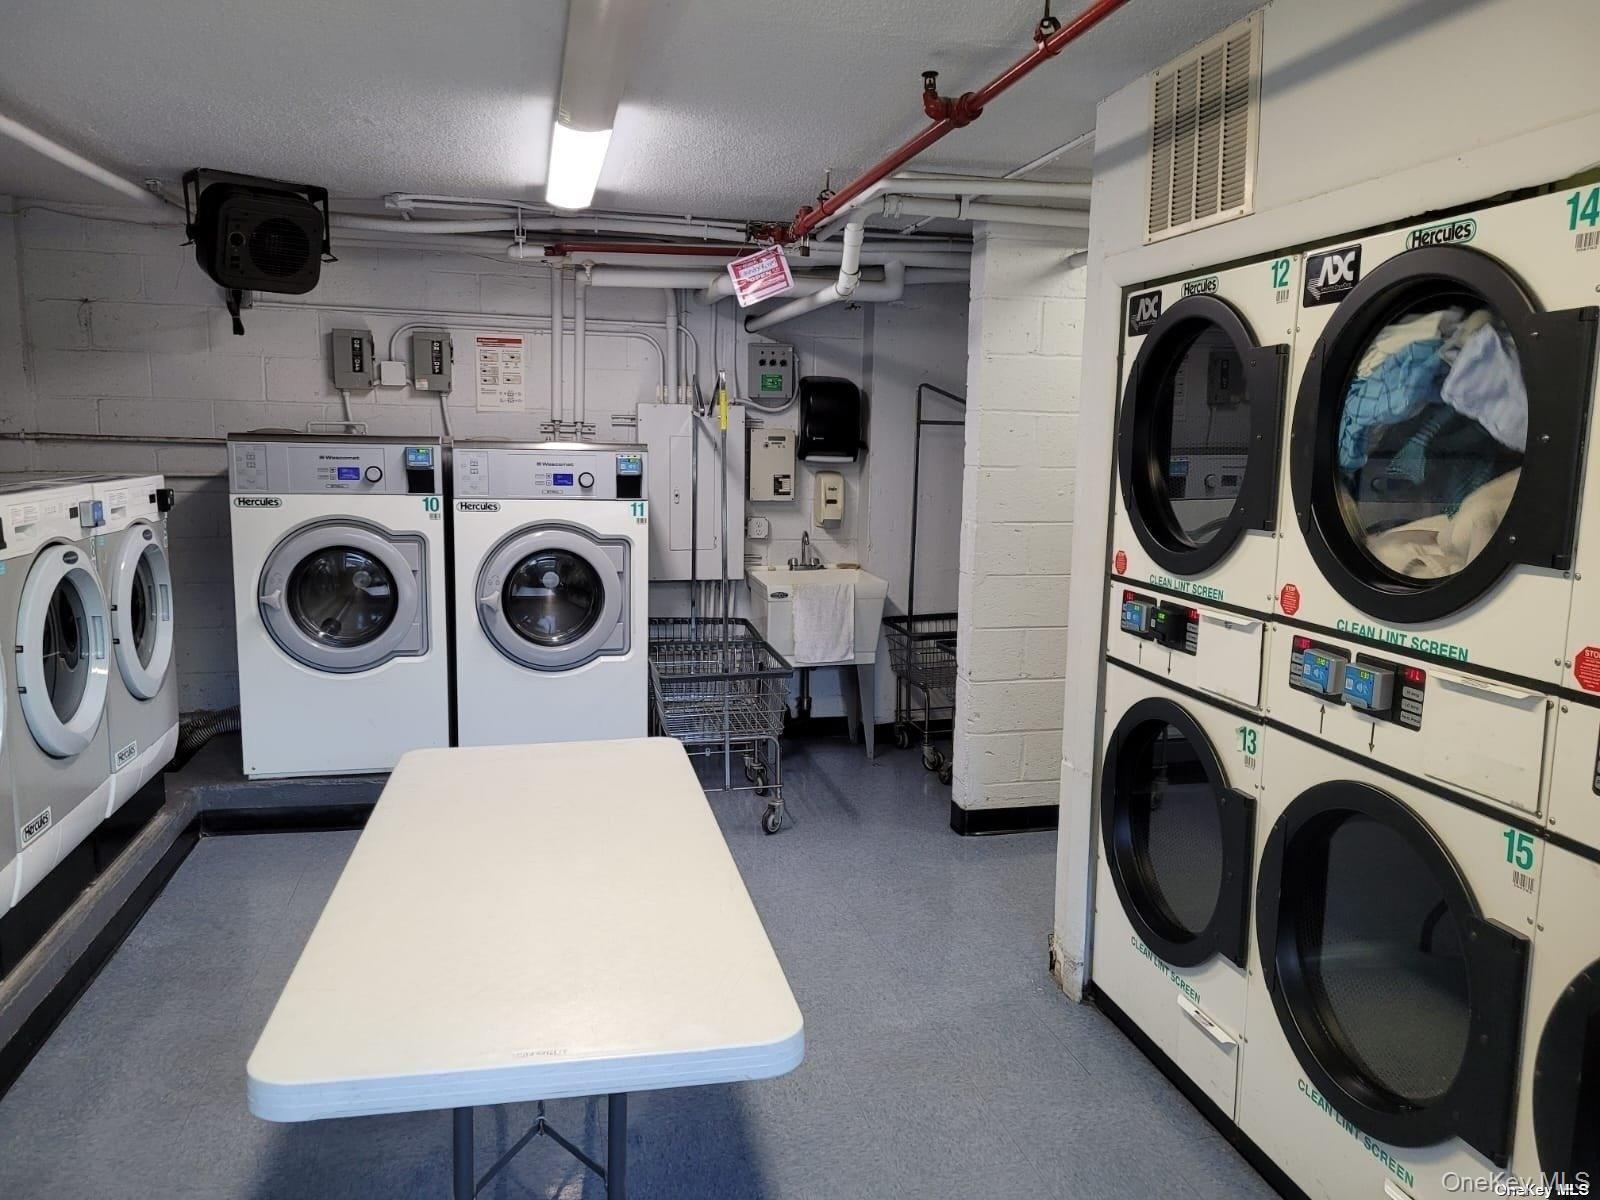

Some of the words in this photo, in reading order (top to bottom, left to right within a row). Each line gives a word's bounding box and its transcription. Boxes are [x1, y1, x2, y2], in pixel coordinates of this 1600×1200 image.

[1567, 187, 1600, 231] 14
[1411, 222, 1472, 249] Hercules
[1271, 258, 1290, 289] 12
[1319, 250, 1356, 286] ADC
[1183, 278, 1217, 296] Hercules
[1136, 295, 1159, 322] ADC
[238, 497, 279, 507] Hercules
[422, 497, 440, 512] 10
[460, 502, 498, 511] Hercules
[630, 503, 645, 517] 11
[1149, 574, 1172, 589] CLEAN
[1174, 580, 1191, 593] LINT
[1192, 584, 1224, 601] SCREEN
[1336, 619, 1375, 639] CLEAN
[1378, 629, 1407, 647] LINT
[1410, 637, 1469, 662] SCREEN
[1584, 649, 1600, 659] STO
[117, 745, 136, 762] Hercules
[1239, 726, 1257, 755] 13
[24, 814, 48, 839] Hercules
[1504, 829, 1534, 870] 15
[1131, 936, 1153, 961] CLEAN
[1153, 956, 1169, 976] LINT
[1170, 971, 1200, 1004] SCREEN
[1297, 1078, 1333, 1117] CLEAN
[1335, 1111, 1361, 1140] LINT
[1363, 1135, 1414, 1188] SCREEN
